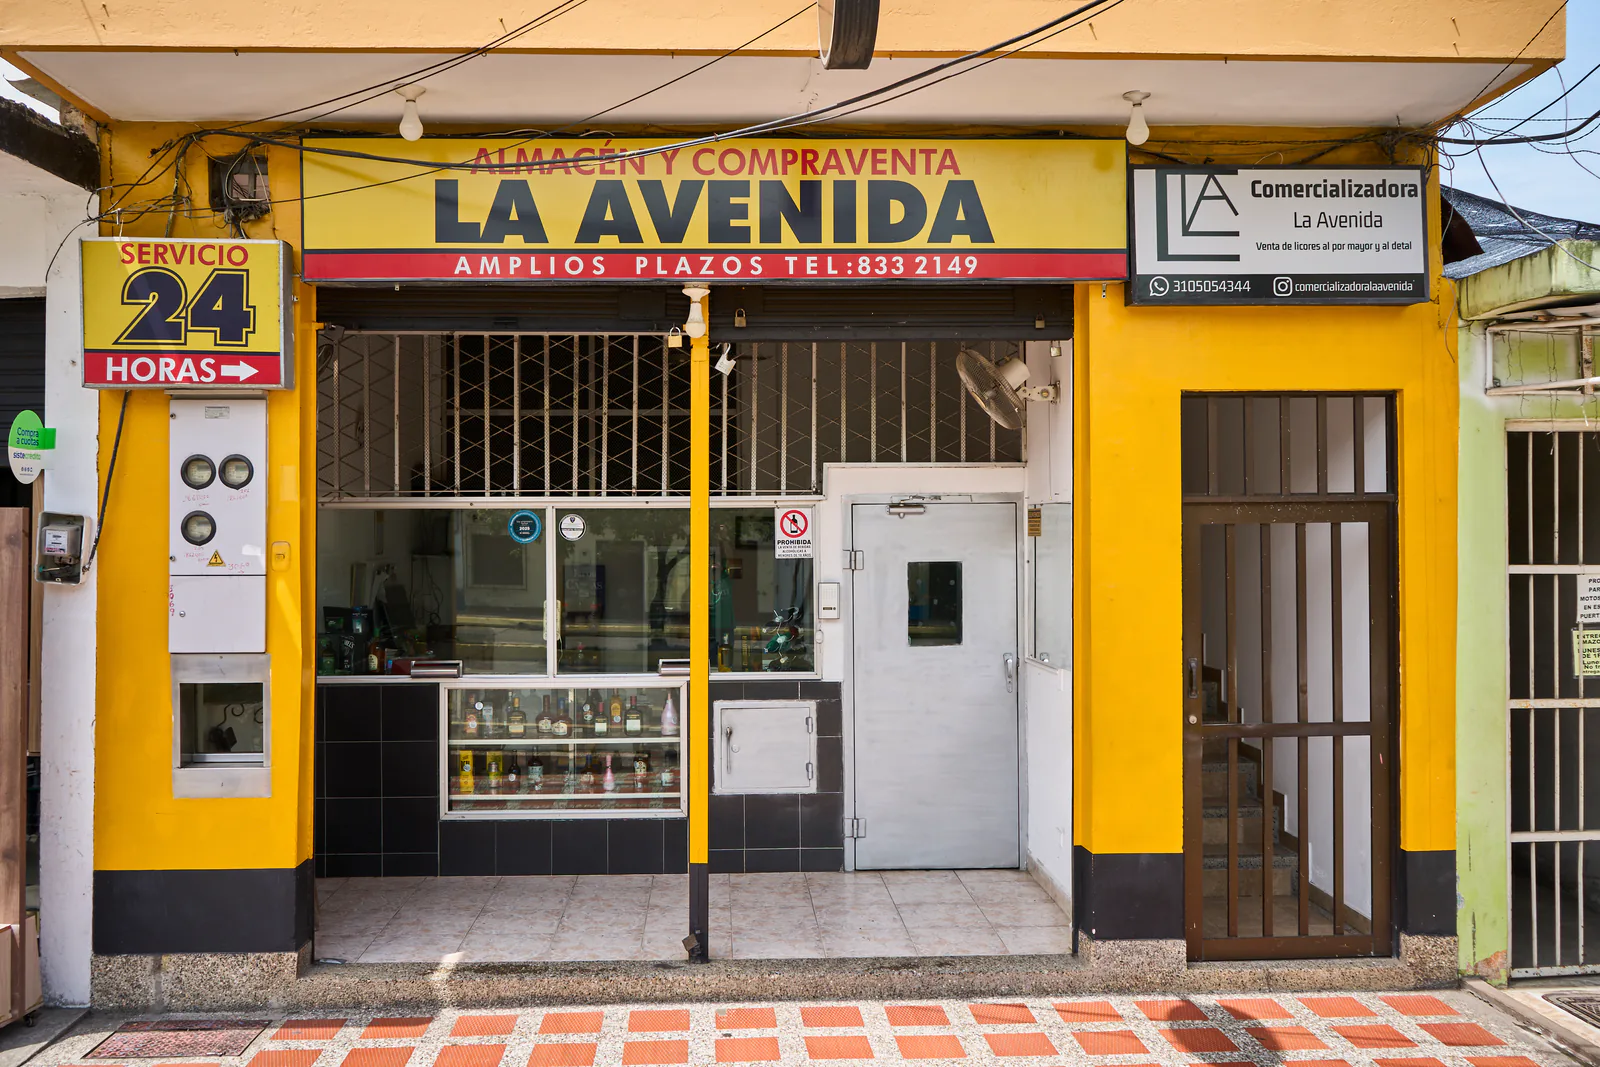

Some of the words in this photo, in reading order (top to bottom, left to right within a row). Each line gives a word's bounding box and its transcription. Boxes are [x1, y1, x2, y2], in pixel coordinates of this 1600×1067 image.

[470, 139, 647, 176] ALMACÉN
[653, 148, 681, 176] Y
[692, 147, 961, 176] COMPRAVENTA
[1250, 178, 1419, 198] Comercializadora
[435, 179, 550, 244] LA
[574, 179, 996, 244] AVENIDA
[1294, 211, 1312, 228] La
[1317, 211, 1383, 228] Avenida
[120, 243, 249, 267] SERVICIO
[1255, 242, 1280, 251] Venta
[1282, 242, 1293, 250] de
[1294, 242, 1321, 250] licores
[1322, 242, 1330, 250] al
[1332, 242, 1346, 252] por
[1347, 242, 1373, 252] mayor
[1375, 242, 1380, 252] y
[1382, 241, 1390, 250] al
[1391, 241, 1412, 250] detal
[454, 255, 607, 276] AMPLIOS
[635, 255, 764, 276] PLAZOS
[914, 255, 979, 276] 2149
[1173, 280, 1251, 292] 3105054344
[1294, 280, 1413, 292] comercializadoralaavenida
[112, 266, 256, 347] 24
[106, 356, 217, 383] HORAS
[17, 427, 39, 438] Compra
[21, 437, 39, 446] cuotas
